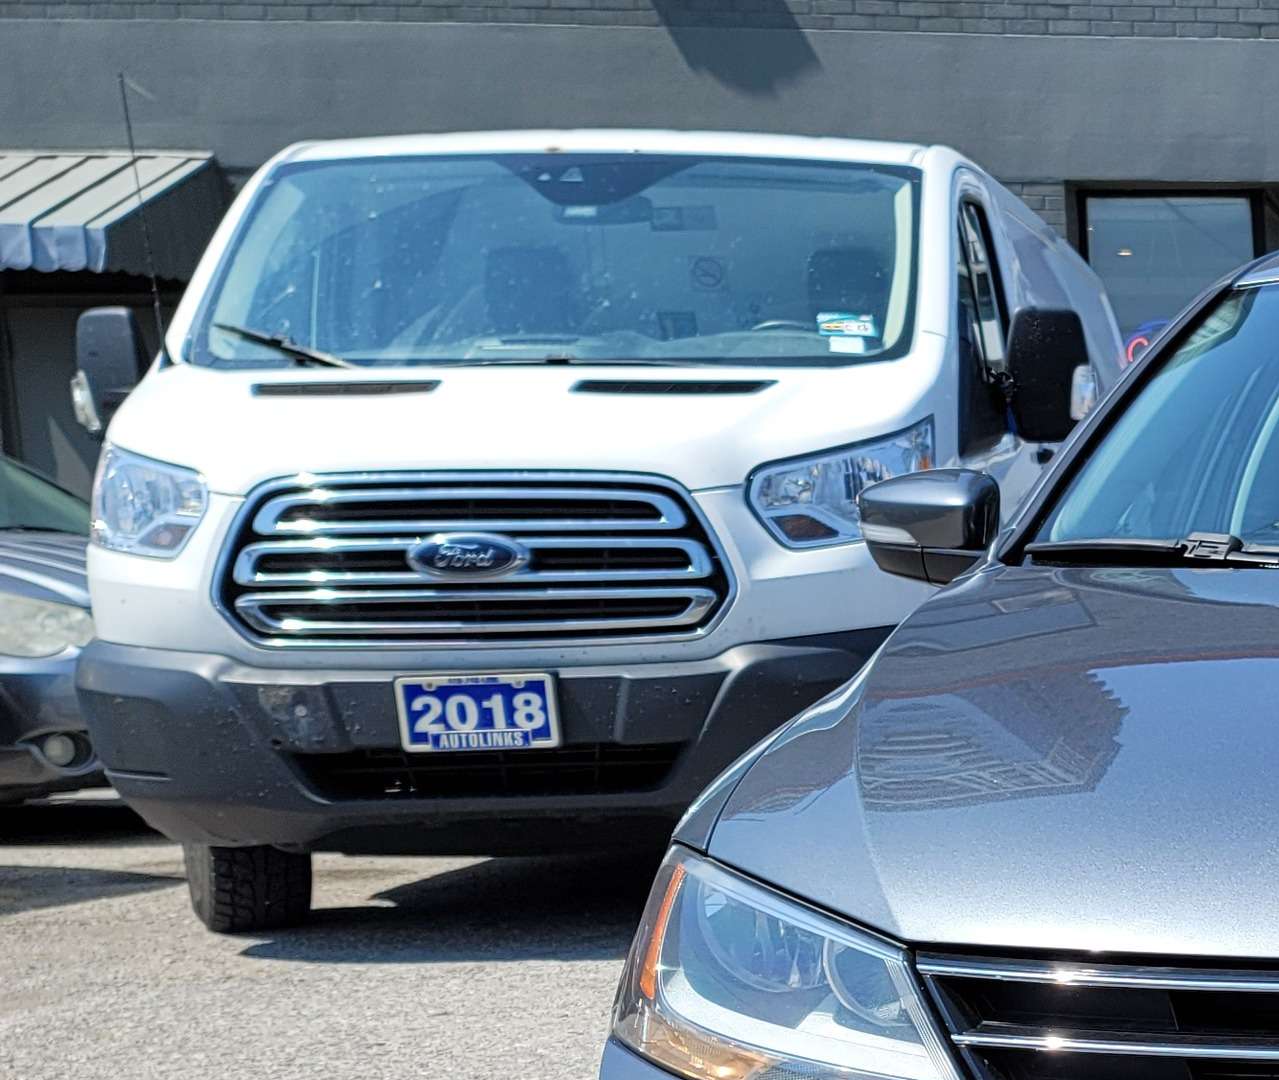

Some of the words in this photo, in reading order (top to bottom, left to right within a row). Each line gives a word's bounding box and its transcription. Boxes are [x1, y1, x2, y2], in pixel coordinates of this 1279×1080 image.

[434, 543, 494, 568] Ford
[410, 692, 546, 733] 2018
[438, 731, 524, 748] AUTOLINKS
